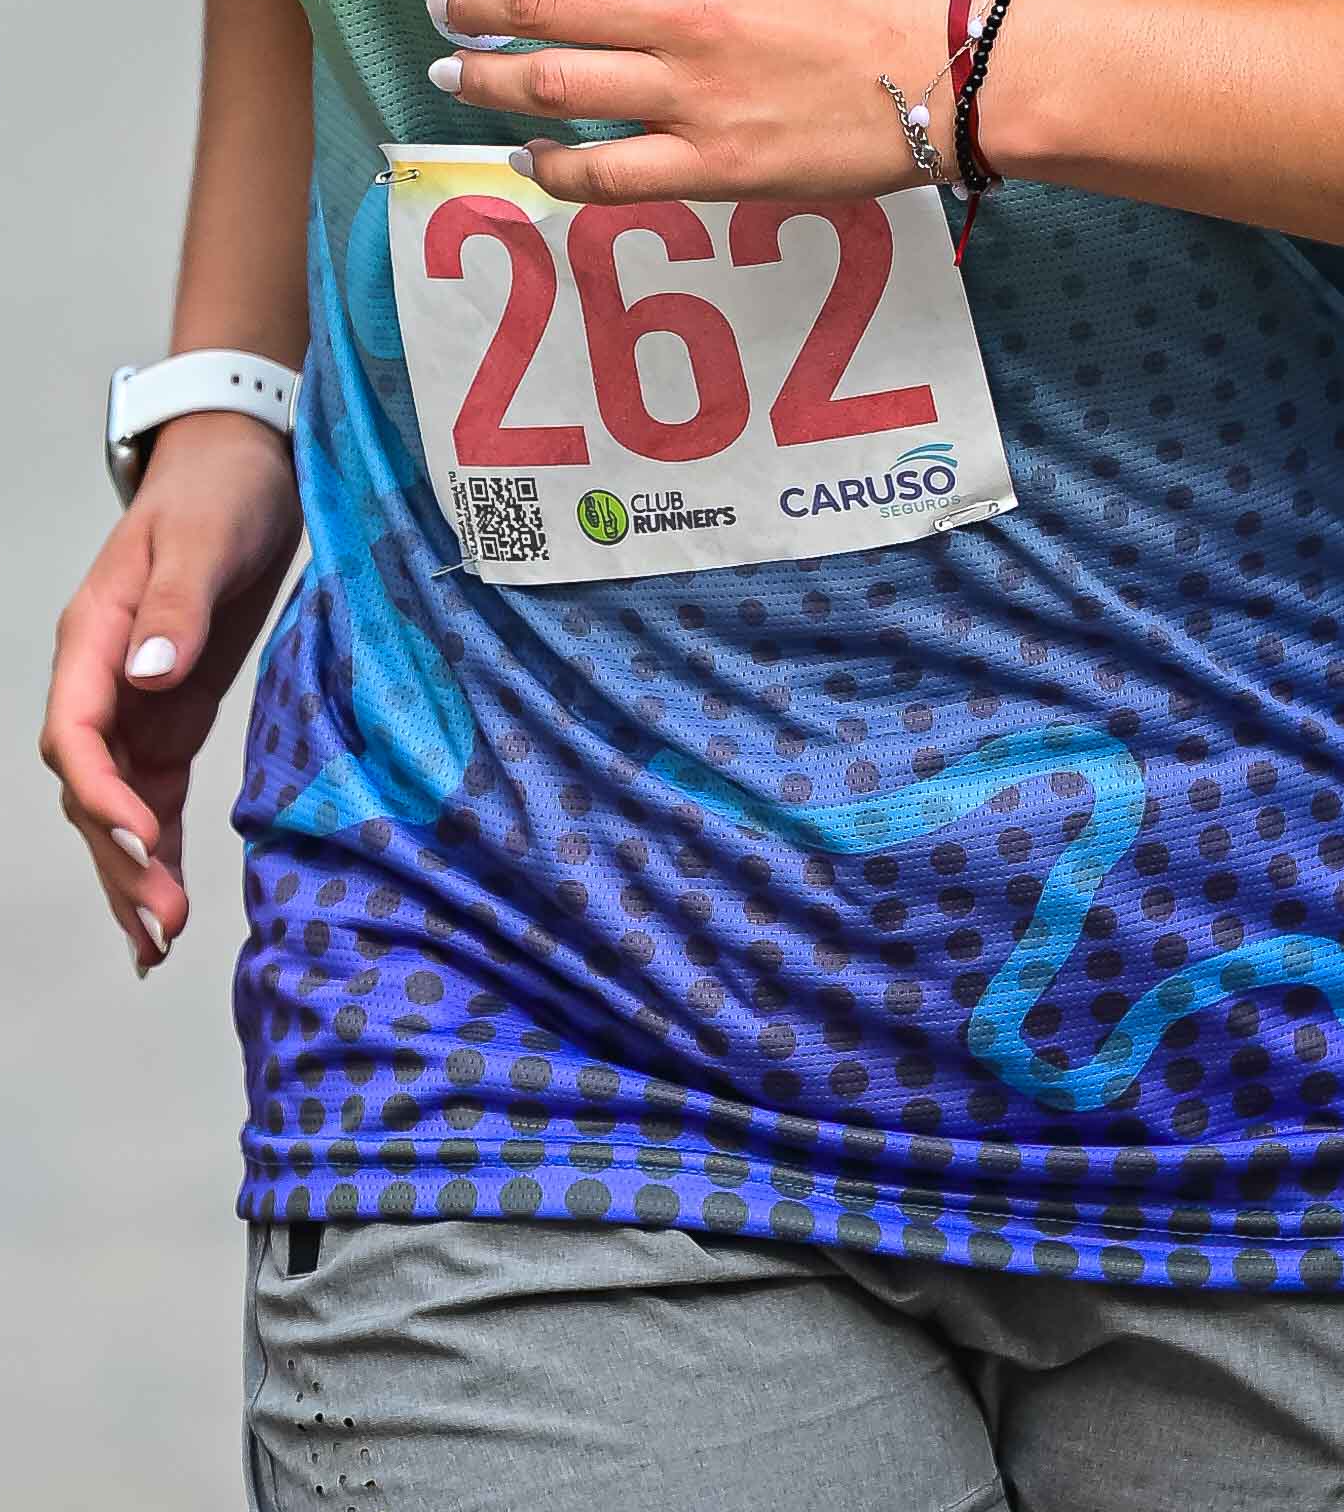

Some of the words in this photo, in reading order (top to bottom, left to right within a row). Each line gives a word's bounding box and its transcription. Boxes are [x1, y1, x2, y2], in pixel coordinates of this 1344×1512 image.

[423, 193, 940, 470] 262
[630, 491, 684, 514] CLUB
[779, 465, 956, 518] CARUSO
[879, 494, 961, 519] SEGUROS
